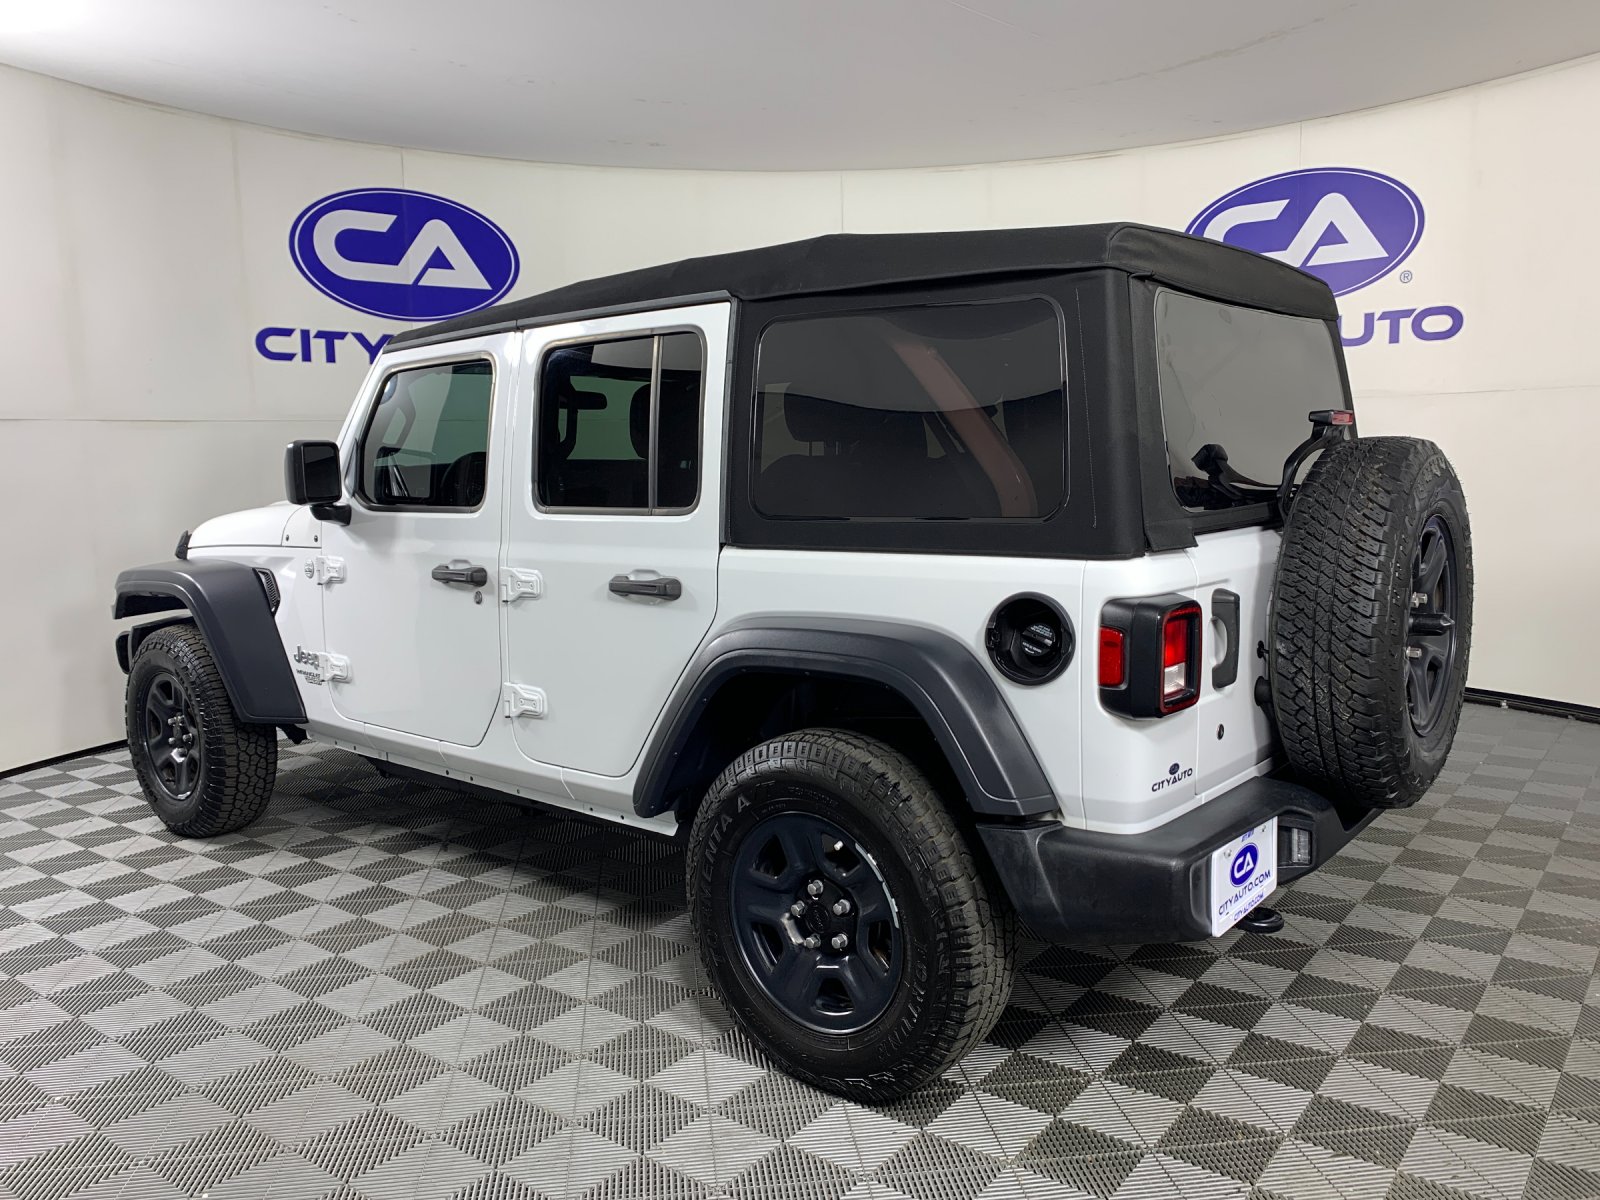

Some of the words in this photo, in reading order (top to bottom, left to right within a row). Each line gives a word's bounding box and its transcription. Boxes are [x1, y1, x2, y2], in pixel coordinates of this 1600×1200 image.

[1203, 192, 1389, 267] CA
[313, 209, 493, 290] CA
[293, 645, 320, 670] Jeep
[1151, 767, 1193, 792] CITYAUTO
[1233, 851, 1255, 878] CA
[1218, 869, 1271, 915] CITYAUTO.COM
